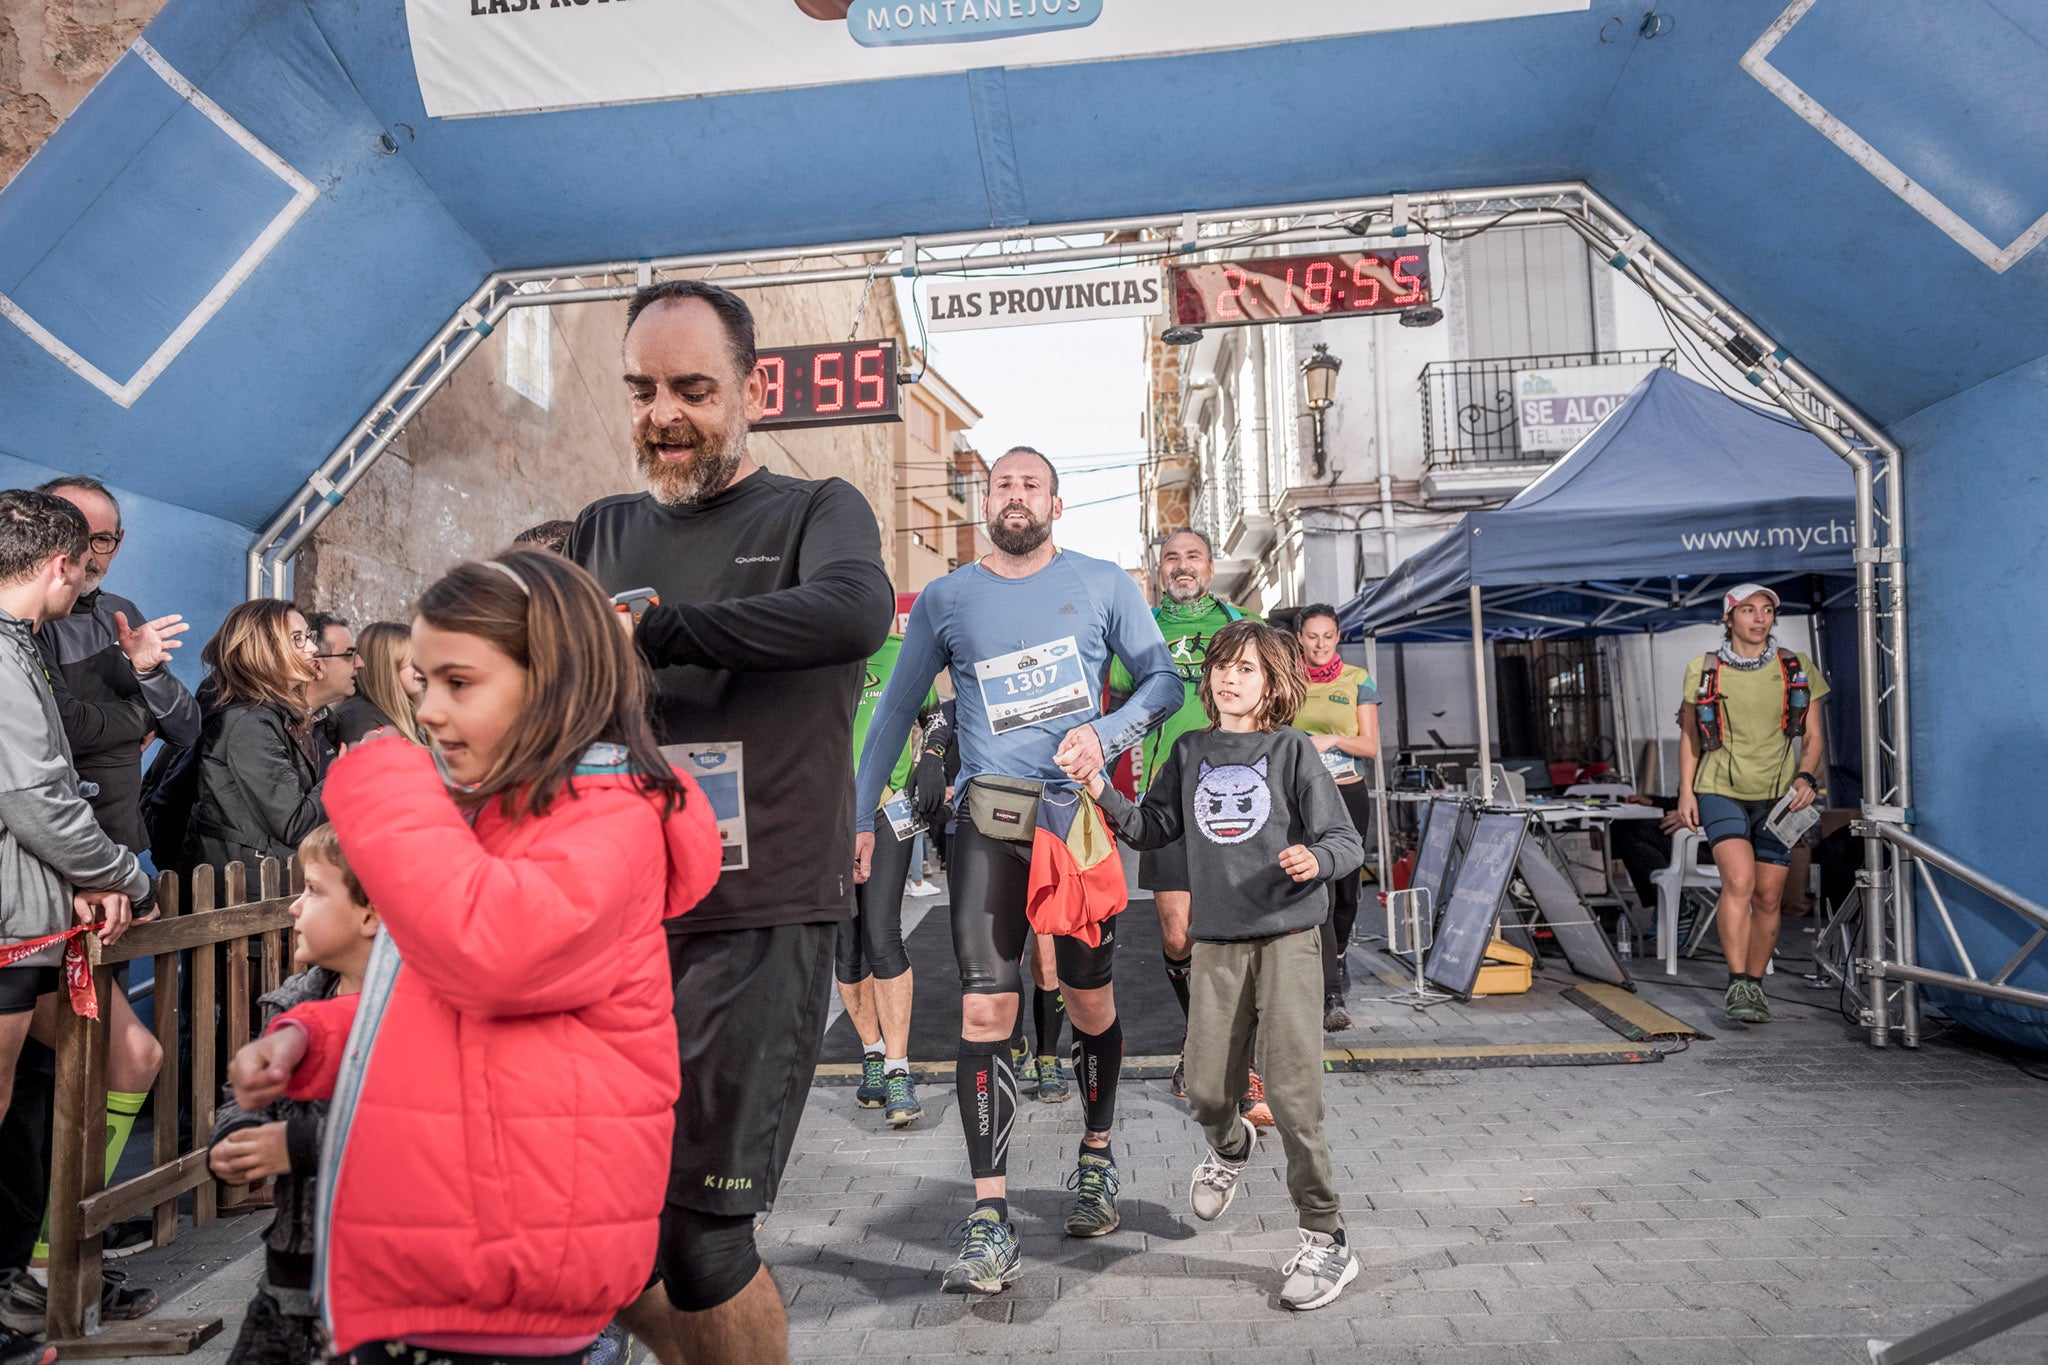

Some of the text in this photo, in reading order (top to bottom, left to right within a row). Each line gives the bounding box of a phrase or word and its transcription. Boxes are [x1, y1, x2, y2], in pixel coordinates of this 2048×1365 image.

[930, 278, 1159, 321] LAS PROVINCIAS
[1524, 400, 1554, 425] SE
[1681, 518, 1877, 552] www.mychi
[734, 555, 780, 565] Quechua
[1004, 664, 1058, 696] 1307
[976, 1069, 989, 1137] VELOCHAMPION
[704, 1174, 753, 1190] KIPSTA
